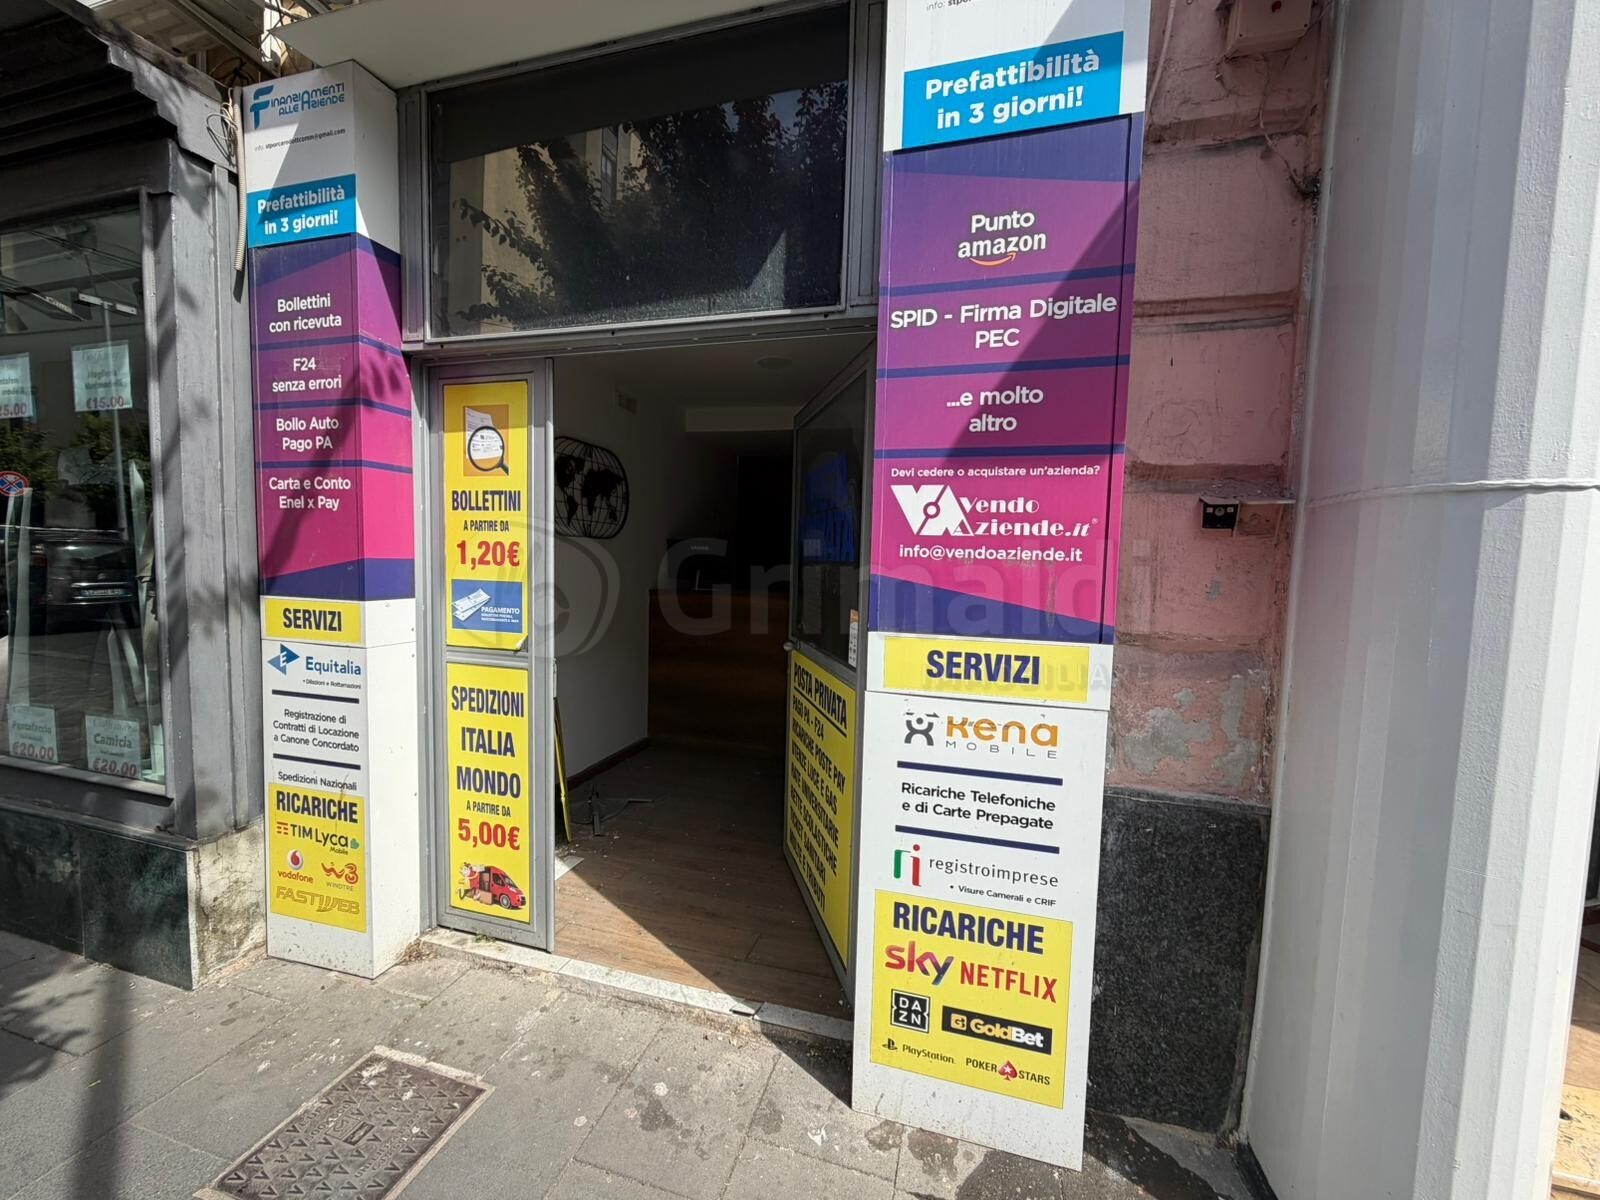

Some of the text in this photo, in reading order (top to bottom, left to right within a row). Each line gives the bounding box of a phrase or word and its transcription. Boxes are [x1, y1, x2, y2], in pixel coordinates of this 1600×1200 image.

[925, 49, 1099, 100] Prefattibilità
[937, 86, 1084, 129] in 3 giorni!
[257, 186, 345, 214] Prefattibilità
[264, 210, 338, 234] in 3 giorni!
[971, 210, 1035, 233] Punto
[958, 233, 1046, 259] amazon
[278, 293, 331, 312] Bollettini
[890, 308, 937, 328] SPID
[960, 304, 1021, 323] Firma
[1030, 293, 1117, 320] Digitale
[269, 314, 342, 333] con ricevuta
[975, 328, 1020, 348] PEC
[293, 357, 316, 372] F24
[272, 375, 342, 392] senza errori
[979, 386, 1043, 405] molto
[276, 417, 339, 430] Bollo Auto
[969, 414, 1017, 432] altro
[282, 437, 333, 451] Pago PA
[891, 468, 914, 478] Devi
[918, 467, 954, 477] cedere
[967, 467, 1026, 478] acquistare
[1030, 465, 1100, 476] un'azienda?
[269, 477, 351, 490] Carta e Conto
[279, 496, 339, 511] Enel x Pay
[452, 490, 520, 511] BOLLETTINI
[464, 520, 509, 531] A PARTIRE DA
[457, 540, 520, 570] 1,20€
[899, 545, 1083, 562] info@vendoaziende.it
[282, 608, 342, 632] SERVIZI
[481, 606, 520, 614] PAGAMENTO
[305, 656, 361, 676] Equitalia
[926, 650, 1040, 685] SERVIZI
[451, 685, 524, 717] SPEDIZIONI
[793, 660, 847, 730] POSTA PRIVATA
[284, 709, 346, 724] Registrazione di
[273, 720, 359, 739] Contratti di Locazione
[814, 715, 824, 741] F24
[94, 733, 132, 749] Camicia
[280, 733, 309, 745] Canone
[312, 737, 359, 752] Concordato
[461, 726, 515, 757] ITALIA
[946, 740, 1057, 759] MOBILE
[93, 758, 137, 777] €20.00
[815, 743, 832, 780] POSTE
[833, 765, 845, 797] PAY
[278, 771, 357, 791] Spedizioni Nazionali
[457, 766, 520, 799] MONDO
[276, 790, 358, 824] RICARICHE
[825, 783, 837, 817] GAS
[902, 782, 1056, 811] Ricariche Telefoniche
[467, 800, 511, 817] A PARTIRE DA
[902, 801, 1053, 830] e di Carte Prepagate
[290, 824, 348, 847] TIM Lyca
[458, 818, 520, 850] 5,00€
[278, 870, 313, 884] vodafone
[929, 857, 1059, 887] registroimprese
[326, 882, 353, 892] WINDTRE
[958, 885, 984, 896] Visure
[987, 889, 1023, 902] Camerali
[1034, 897, 1056, 907] CRIF
[276, 886, 360, 914] FASTWEB
[893, 902, 1044, 955] RICARICHE
[885, 941, 1057, 1003] sky NETFLIX
[970, 1018, 1044, 1048] GoldBet
[903, 1044, 955, 1064] PlayStation
[966, 1057, 1050, 1086] POKER STARS
